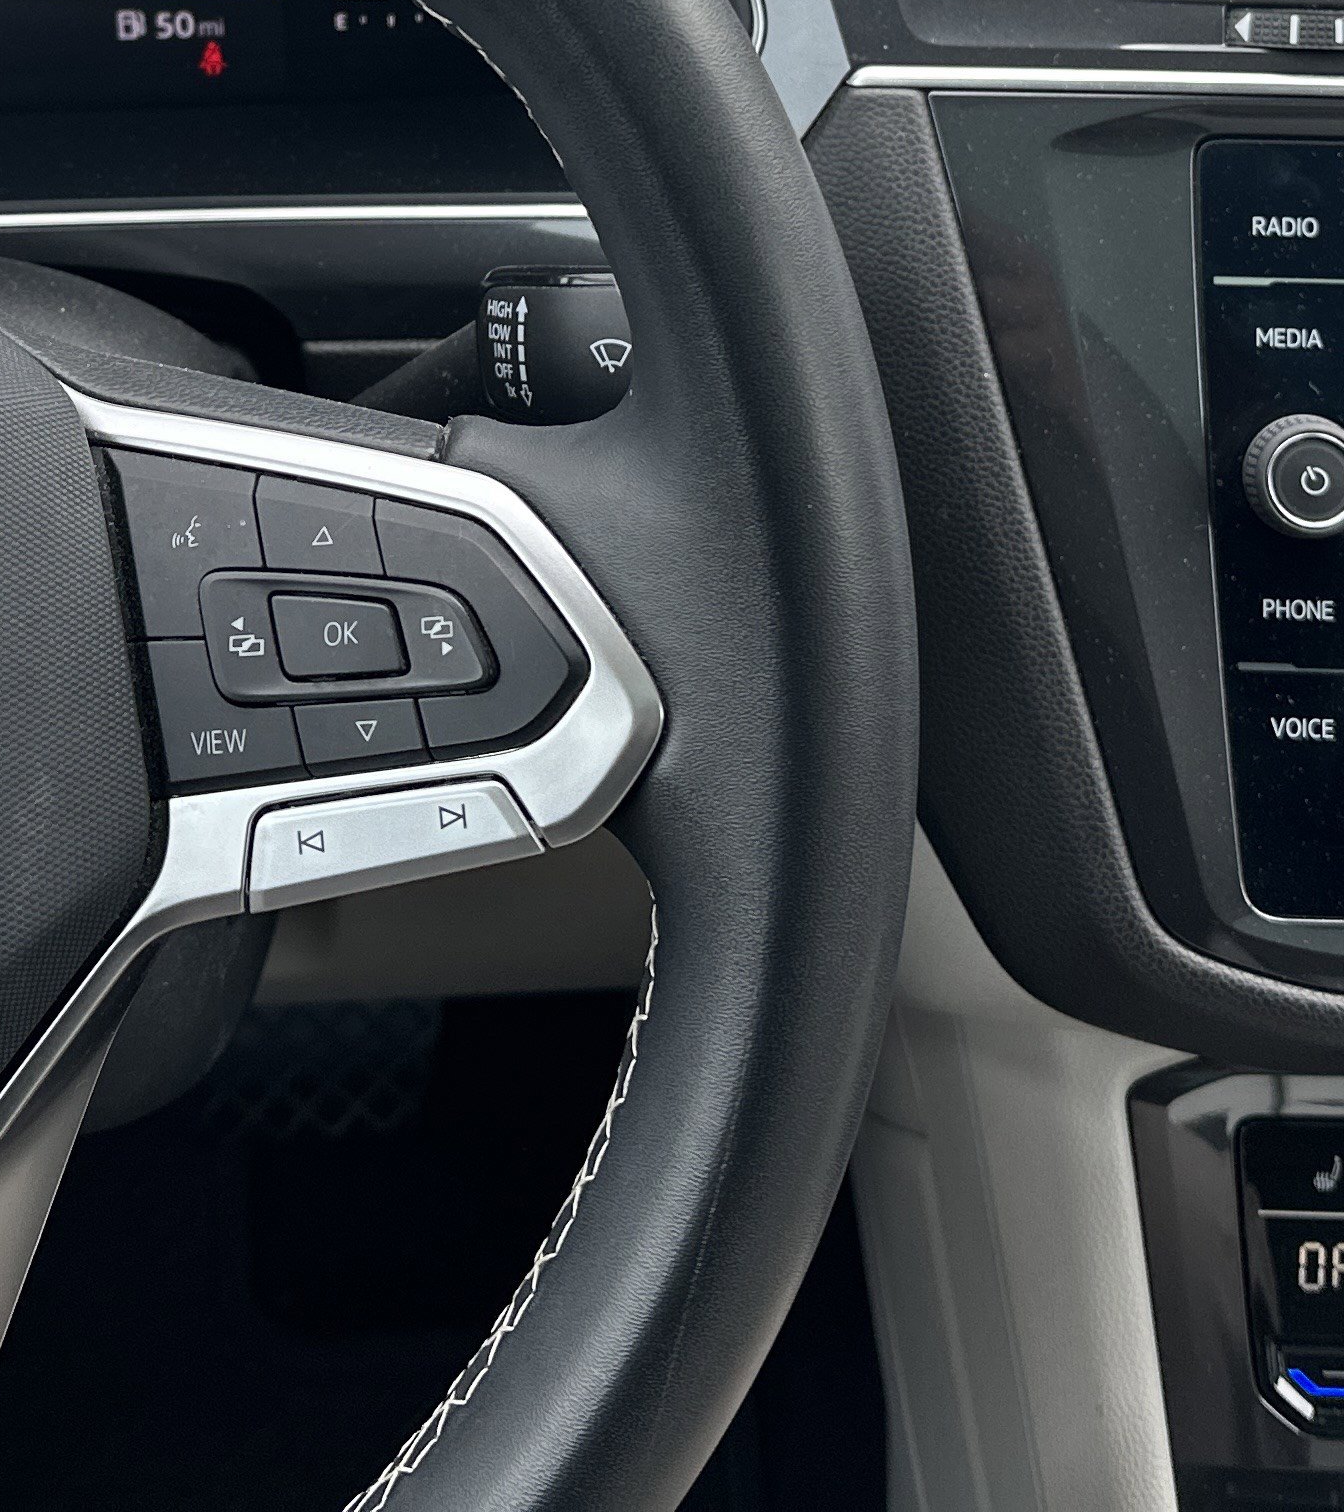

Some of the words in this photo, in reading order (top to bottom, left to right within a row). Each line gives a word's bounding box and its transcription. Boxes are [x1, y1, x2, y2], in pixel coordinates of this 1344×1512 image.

[1251, 215, 1320, 238] RADIO
[487, 299, 514, 319] HIGH
[488, 322, 512, 342] LOW
[1255, 327, 1325, 349] MEDIA
[493, 343, 513, 361] INT
[494, 362, 514, 379] OFF
[1262, 598, 1338, 623] PHONE
[323, 620, 358, 648] OK
[1270, 716, 1338, 741] VOICE
[189, 727, 248, 757] VIEW
